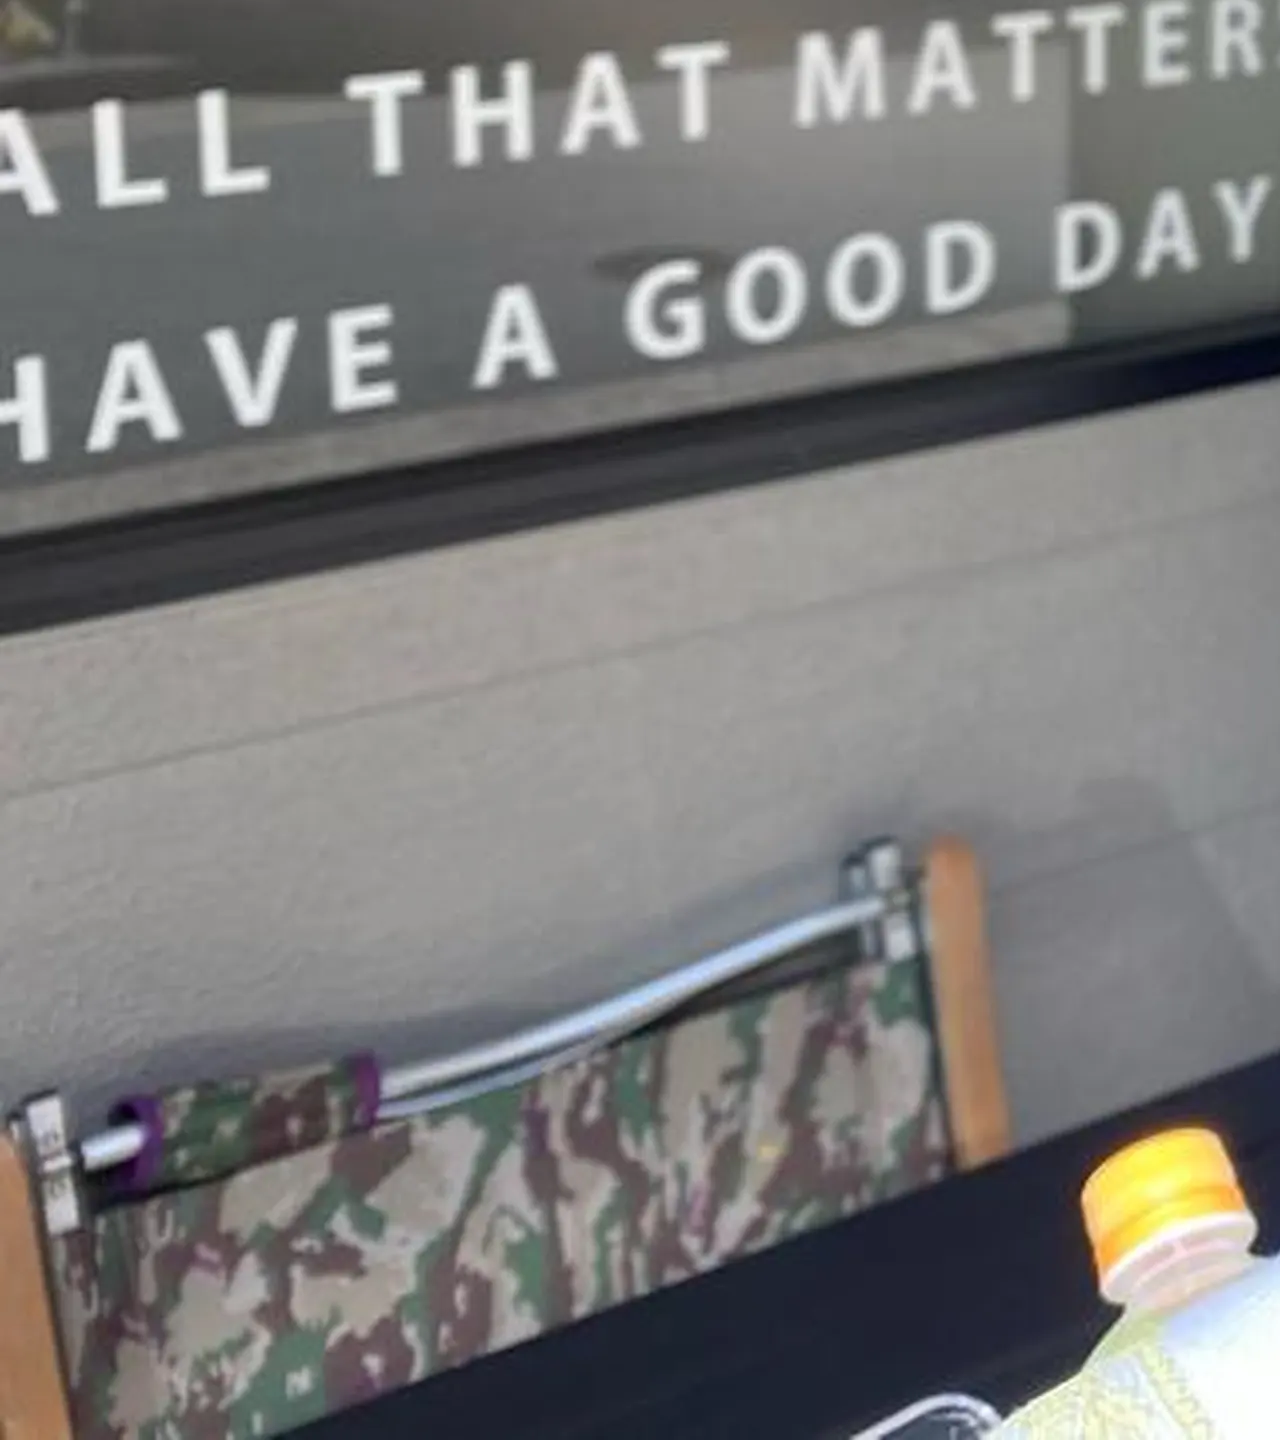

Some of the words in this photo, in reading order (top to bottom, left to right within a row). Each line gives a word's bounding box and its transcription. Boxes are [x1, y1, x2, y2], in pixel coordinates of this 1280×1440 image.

[0, 88, 270, 216] ALL
[345, 41, 730, 176] THAT
[473, 284, 557, 389] A
[624, 221, 995, 345] GOOD
